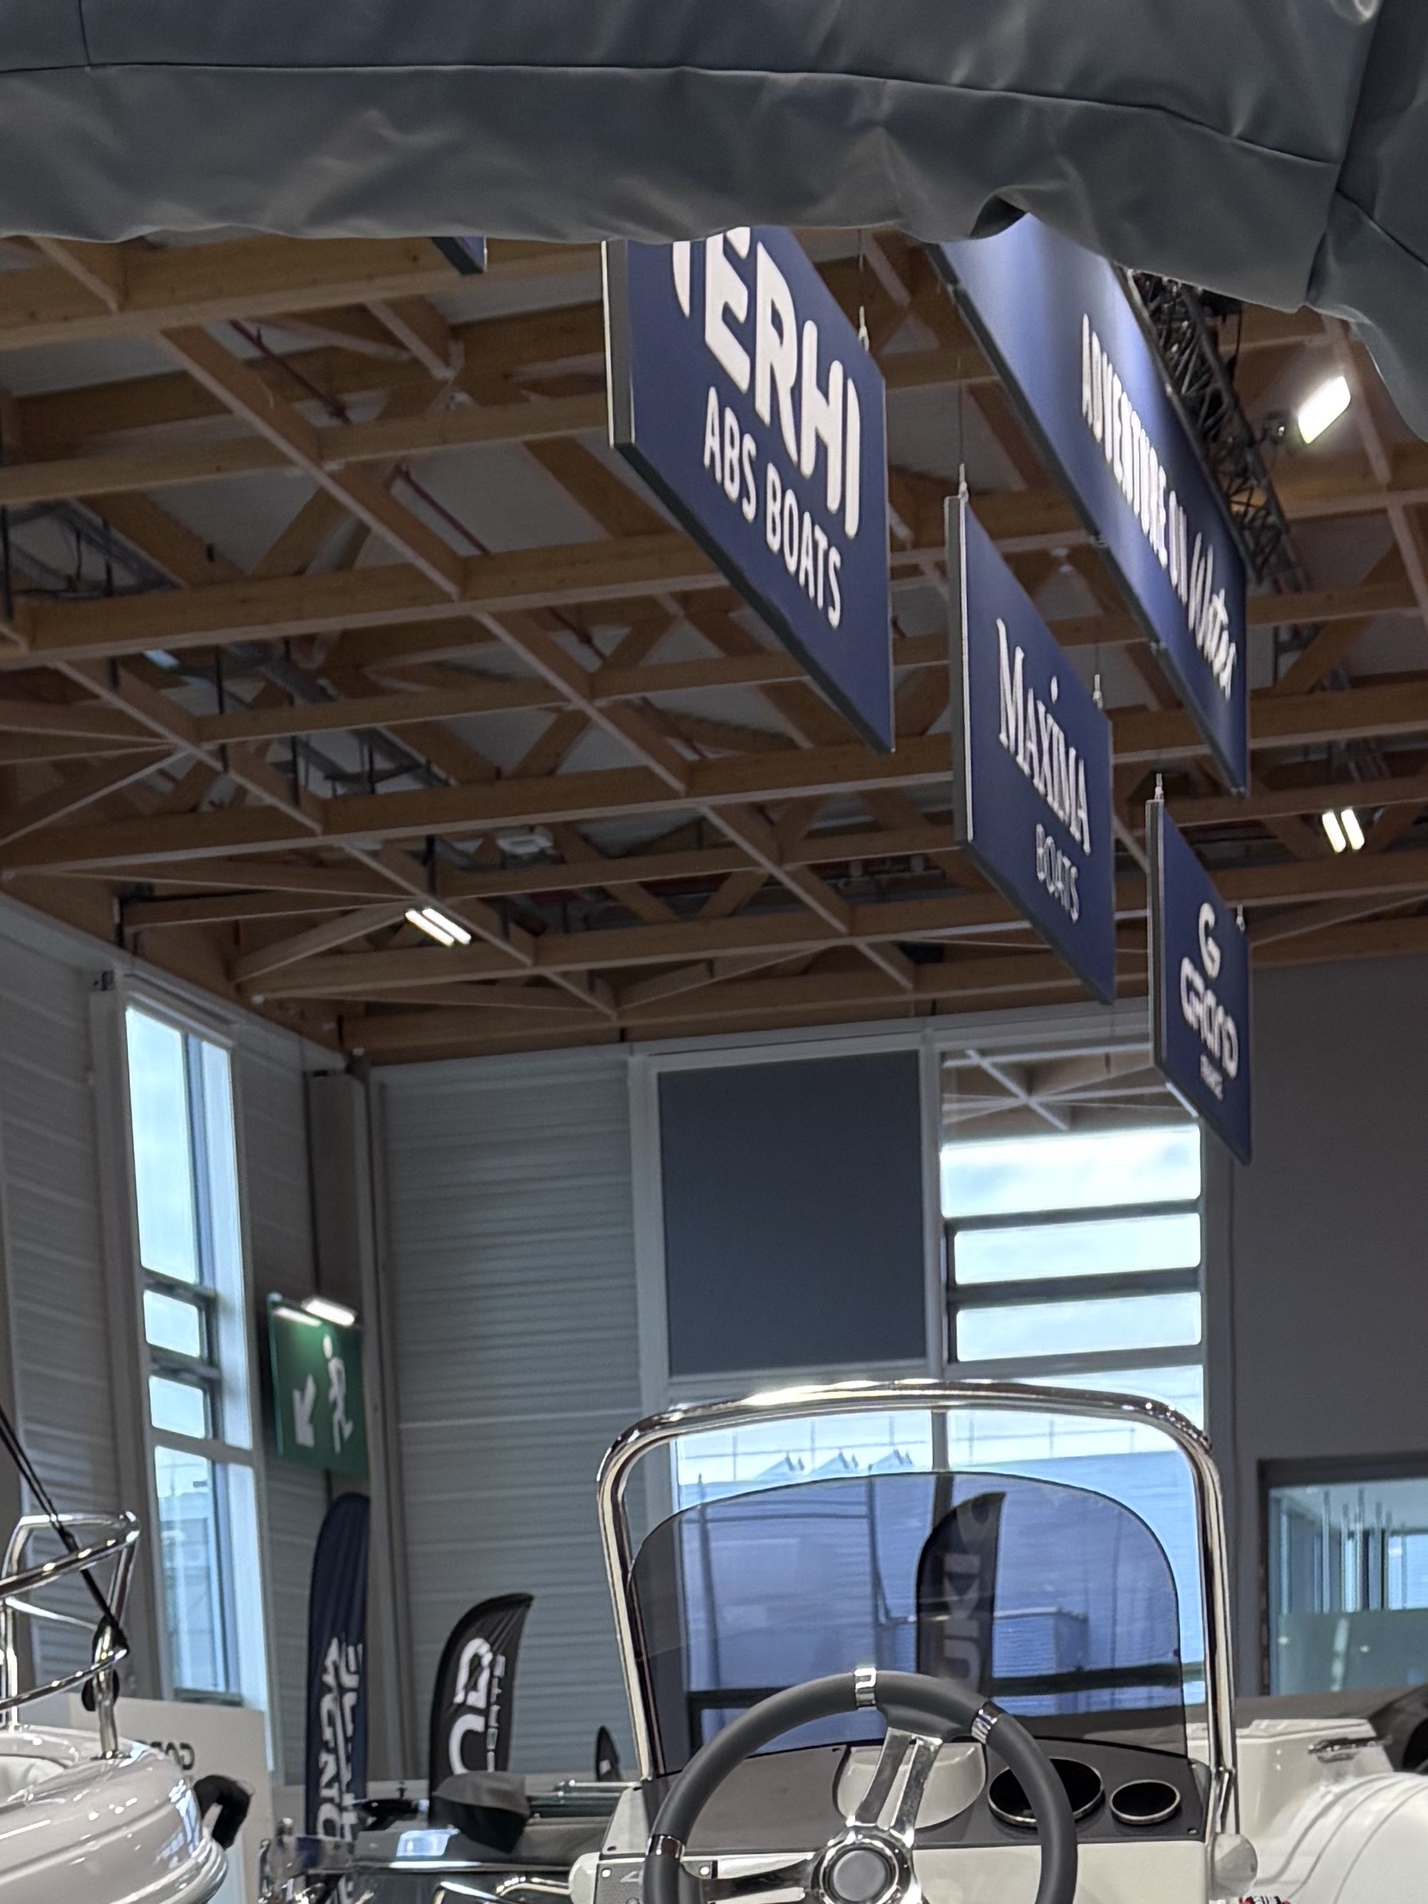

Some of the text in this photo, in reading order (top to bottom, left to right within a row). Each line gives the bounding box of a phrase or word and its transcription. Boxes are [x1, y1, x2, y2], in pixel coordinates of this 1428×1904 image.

[703, 386, 842, 630] ABS BOATS
[1035, 822, 1080, 924] BOATS
